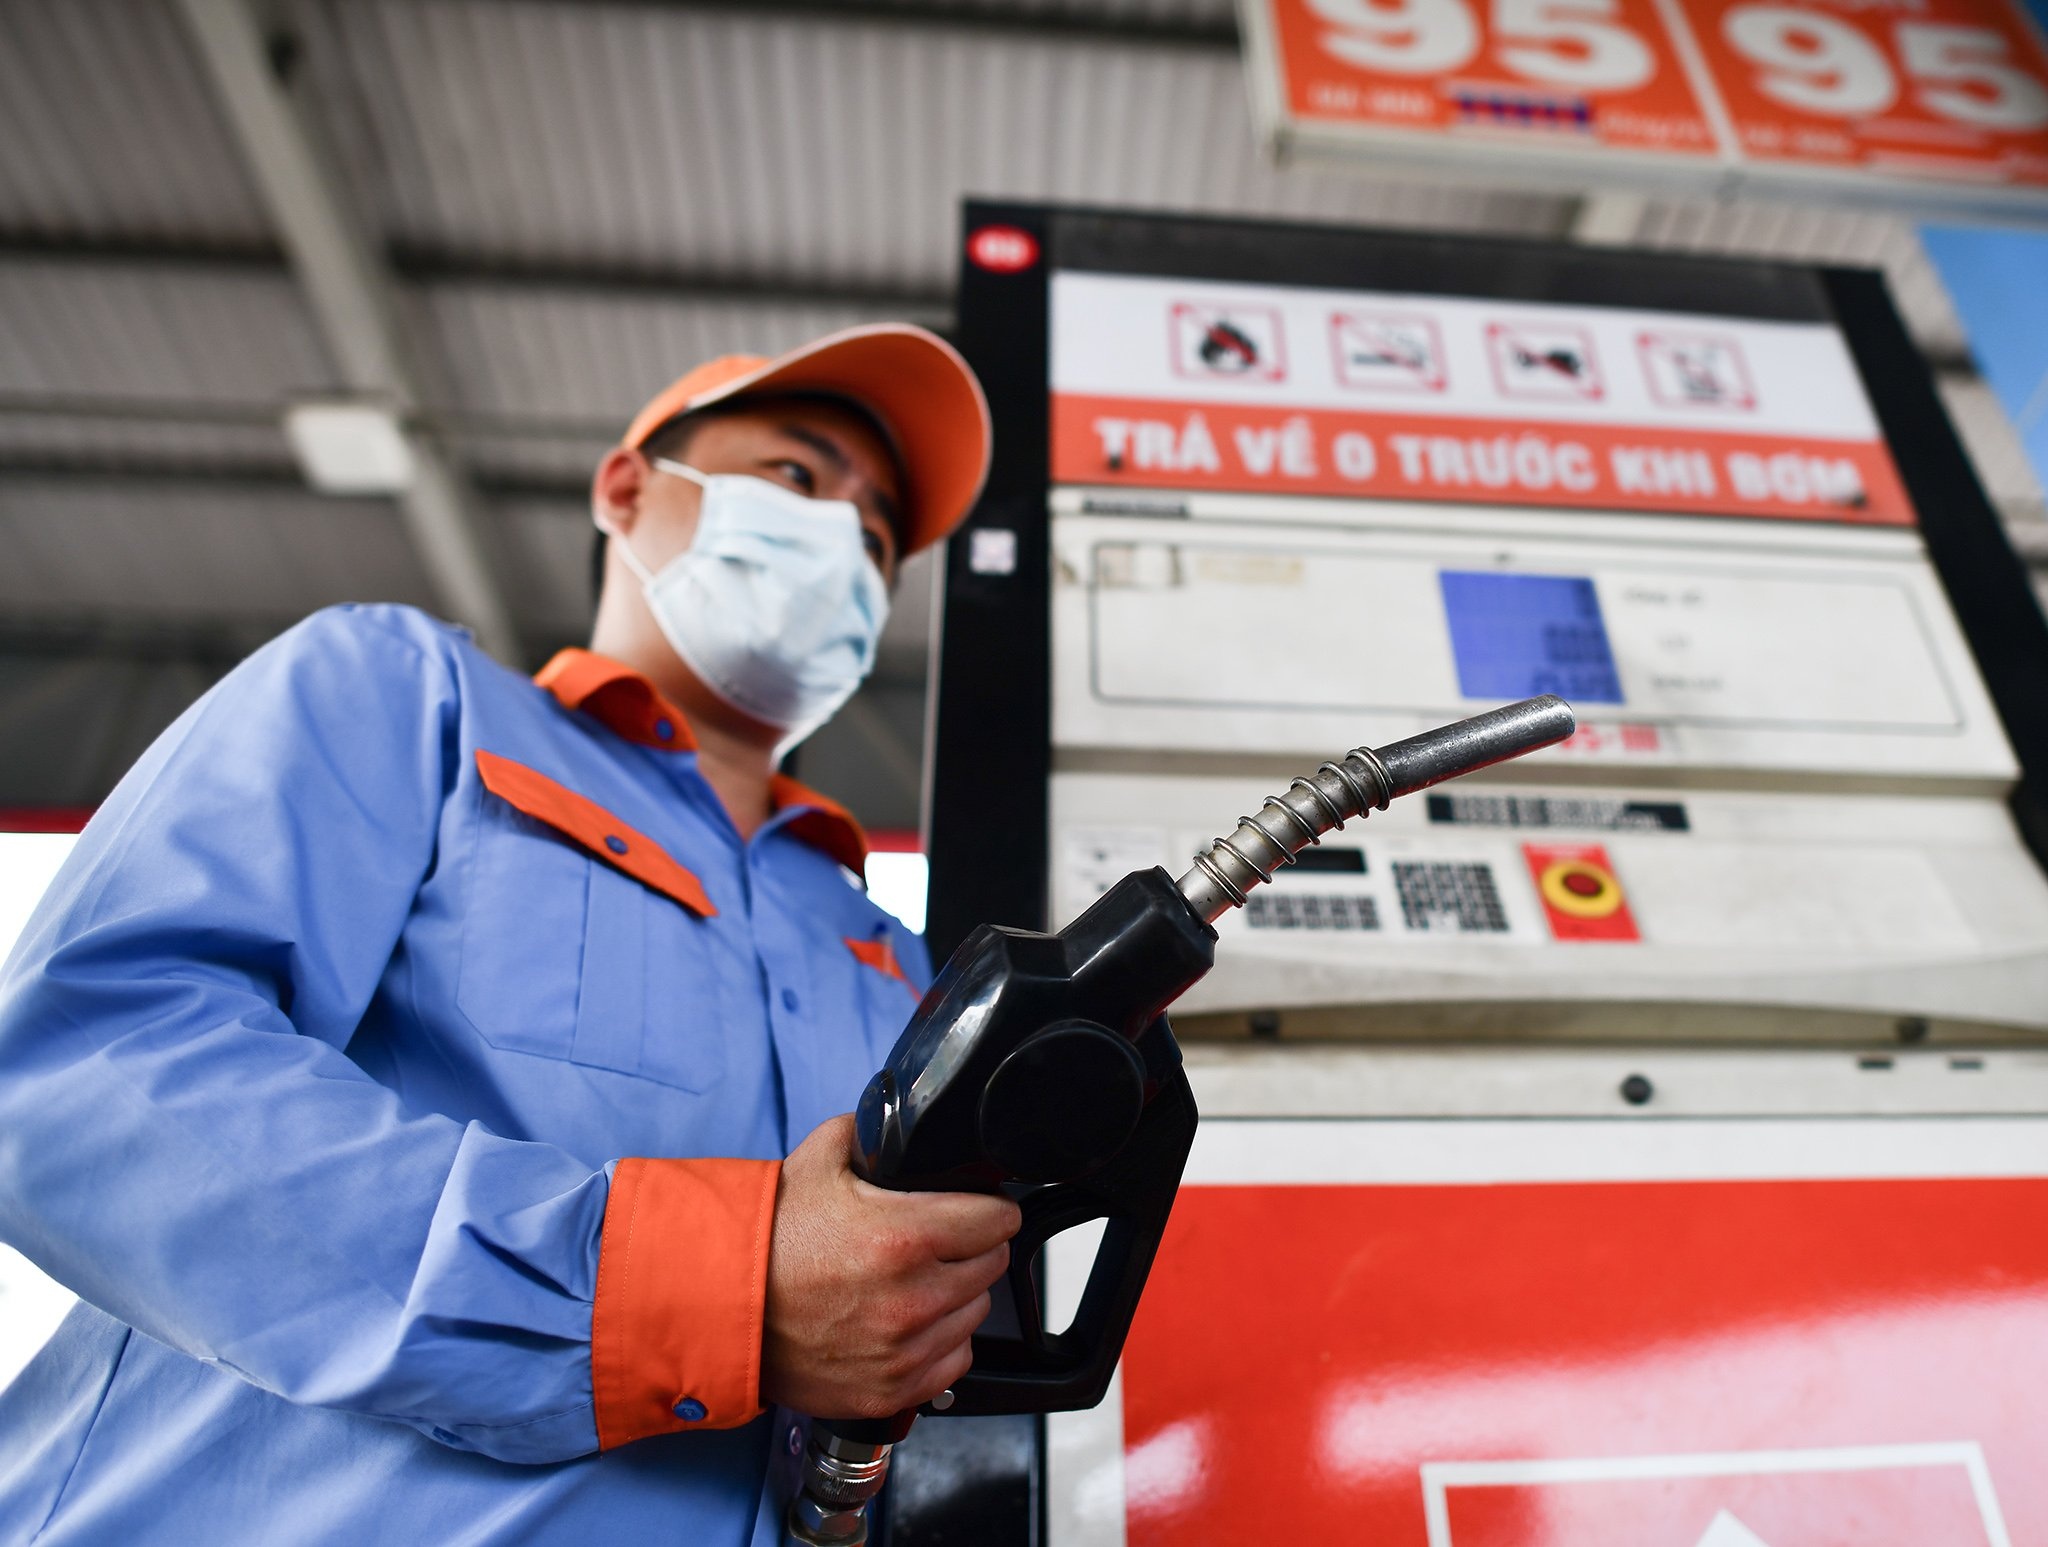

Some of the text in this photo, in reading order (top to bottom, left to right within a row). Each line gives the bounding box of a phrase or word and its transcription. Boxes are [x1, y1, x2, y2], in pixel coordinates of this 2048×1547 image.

[1305, 0, 1656, 92] 95
[1723, 4, 2048, 132] 95
[1611, 445, 1716, 497] KHI
